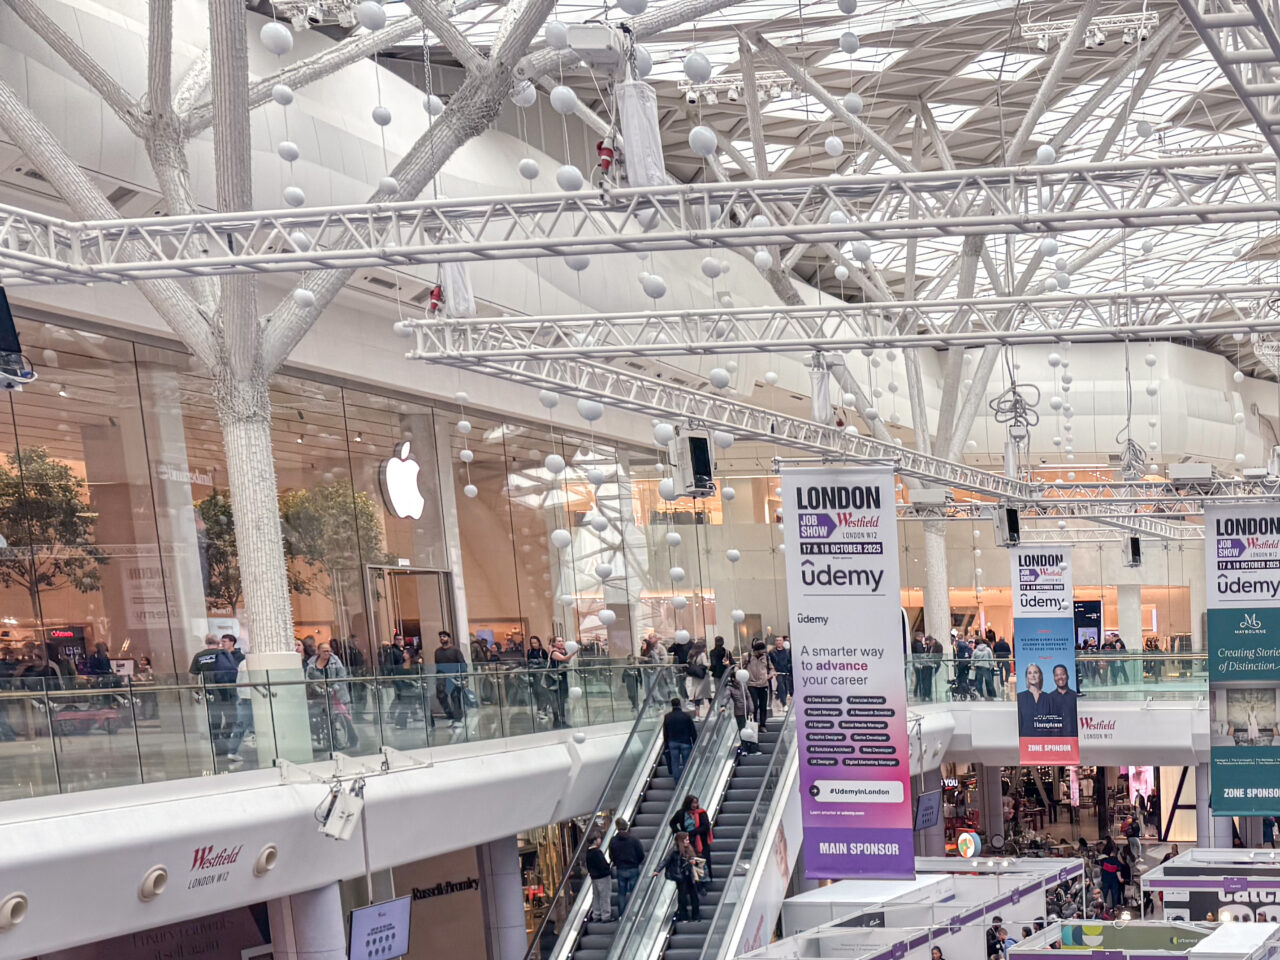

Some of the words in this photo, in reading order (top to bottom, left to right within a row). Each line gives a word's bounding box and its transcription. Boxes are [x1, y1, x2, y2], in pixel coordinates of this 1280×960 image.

[796, 486, 880, 510] LONDON
[801, 515, 818, 526] JOB
[837, 512, 880, 528] Westfield
[802, 526, 828, 537] SHOW
[1216, 517, 1280, 536] LONDON
[802, 544, 811, 553] 17
[831, 544, 862, 553] OCTOBER
[864, 544, 881, 553] 2025
[1218, 539, 1231, 548] JOB
[1246, 538, 1280, 549] Westfield
[1218, 549, 1240, 557] SHOW
[1018, 554, 1064, 568] LONDON
[801, 646, 809, 656] A
[812, 646, 857, 656] smarter
[860, 648, 884, 659] way
[1218, 648, 1255, 660] Creating
[802, 660, 813, 670] to
[816, 660, 868, 671] advance
[1219, 662, 1227, 673] of
[802, 676, 827, 687] your
[830, 676, 868, 685] career
[1080, 717, 1116, 730] Westfield
[1224, 788, 1244, 798] ZONE
[820, 842, 848, 854] MAIN
[850, 843, 899, 855] SPONSOR
[189, 845, 244, 872] Westfield
[188, 875, 215, 890] LONDON
